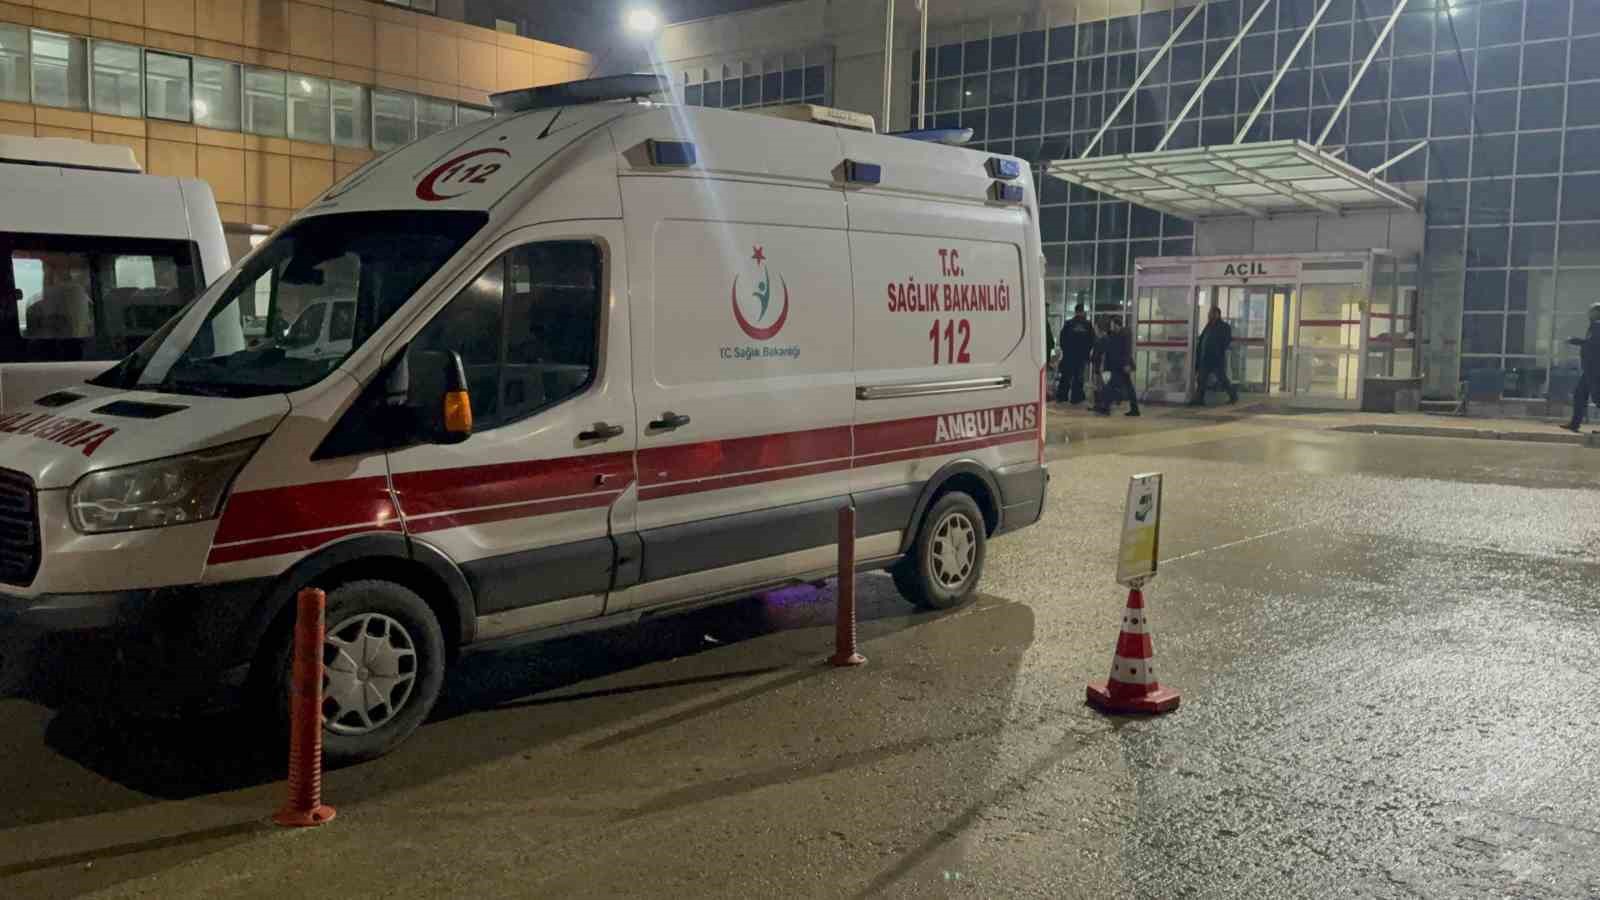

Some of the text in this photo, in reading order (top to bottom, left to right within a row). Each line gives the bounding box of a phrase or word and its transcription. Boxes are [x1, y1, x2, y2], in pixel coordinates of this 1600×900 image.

[441, 163, 501, 184] 112
[938, 248, 965, 277] T.C.
[887, 275, 1010, 313] SAĞLIK BAKANLIĞI
[734, 345, 760, 360] Sağlık
[929, 318, 971, 365] 112
[935, 404, 1036, 443] AMBULANS
